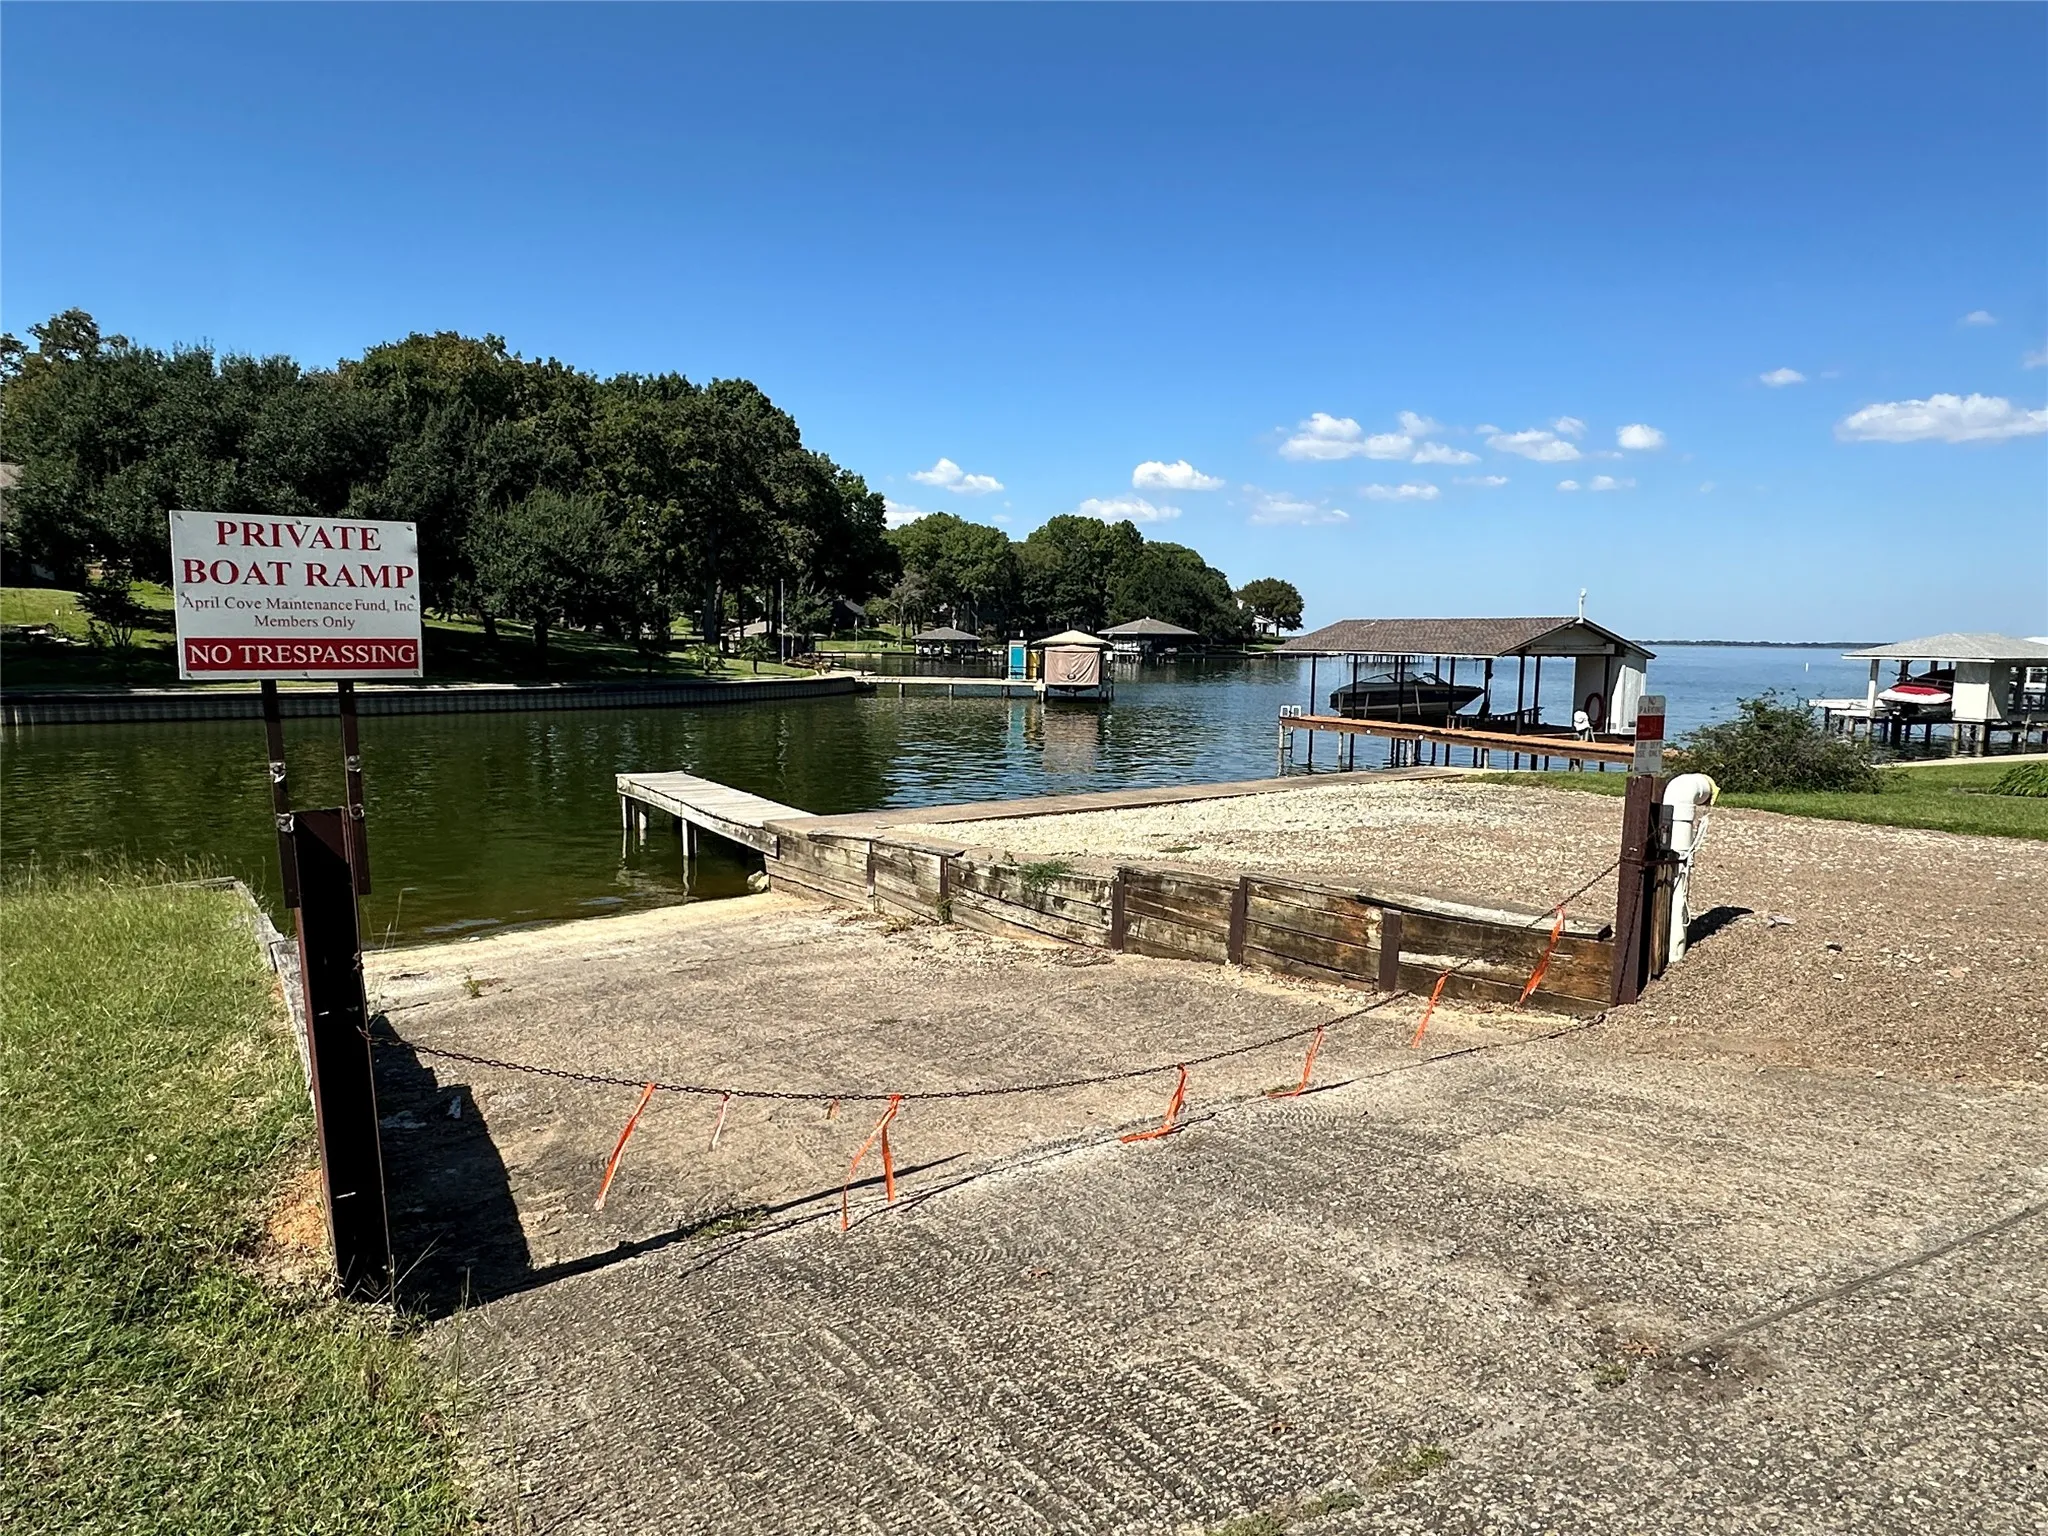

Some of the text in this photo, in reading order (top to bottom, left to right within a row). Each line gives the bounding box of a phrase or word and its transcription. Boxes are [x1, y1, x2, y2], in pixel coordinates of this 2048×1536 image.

[215, 520, 382, 551] PRIVATE
[180, 558, 414, 589] BOAT RAMP
[182, 596, 417, 613] April Cove Maintenance Fund, Inc.
[254, 615, 355, 630] Members Only
[188, 644, 416, 664] NO TRESPASSING
